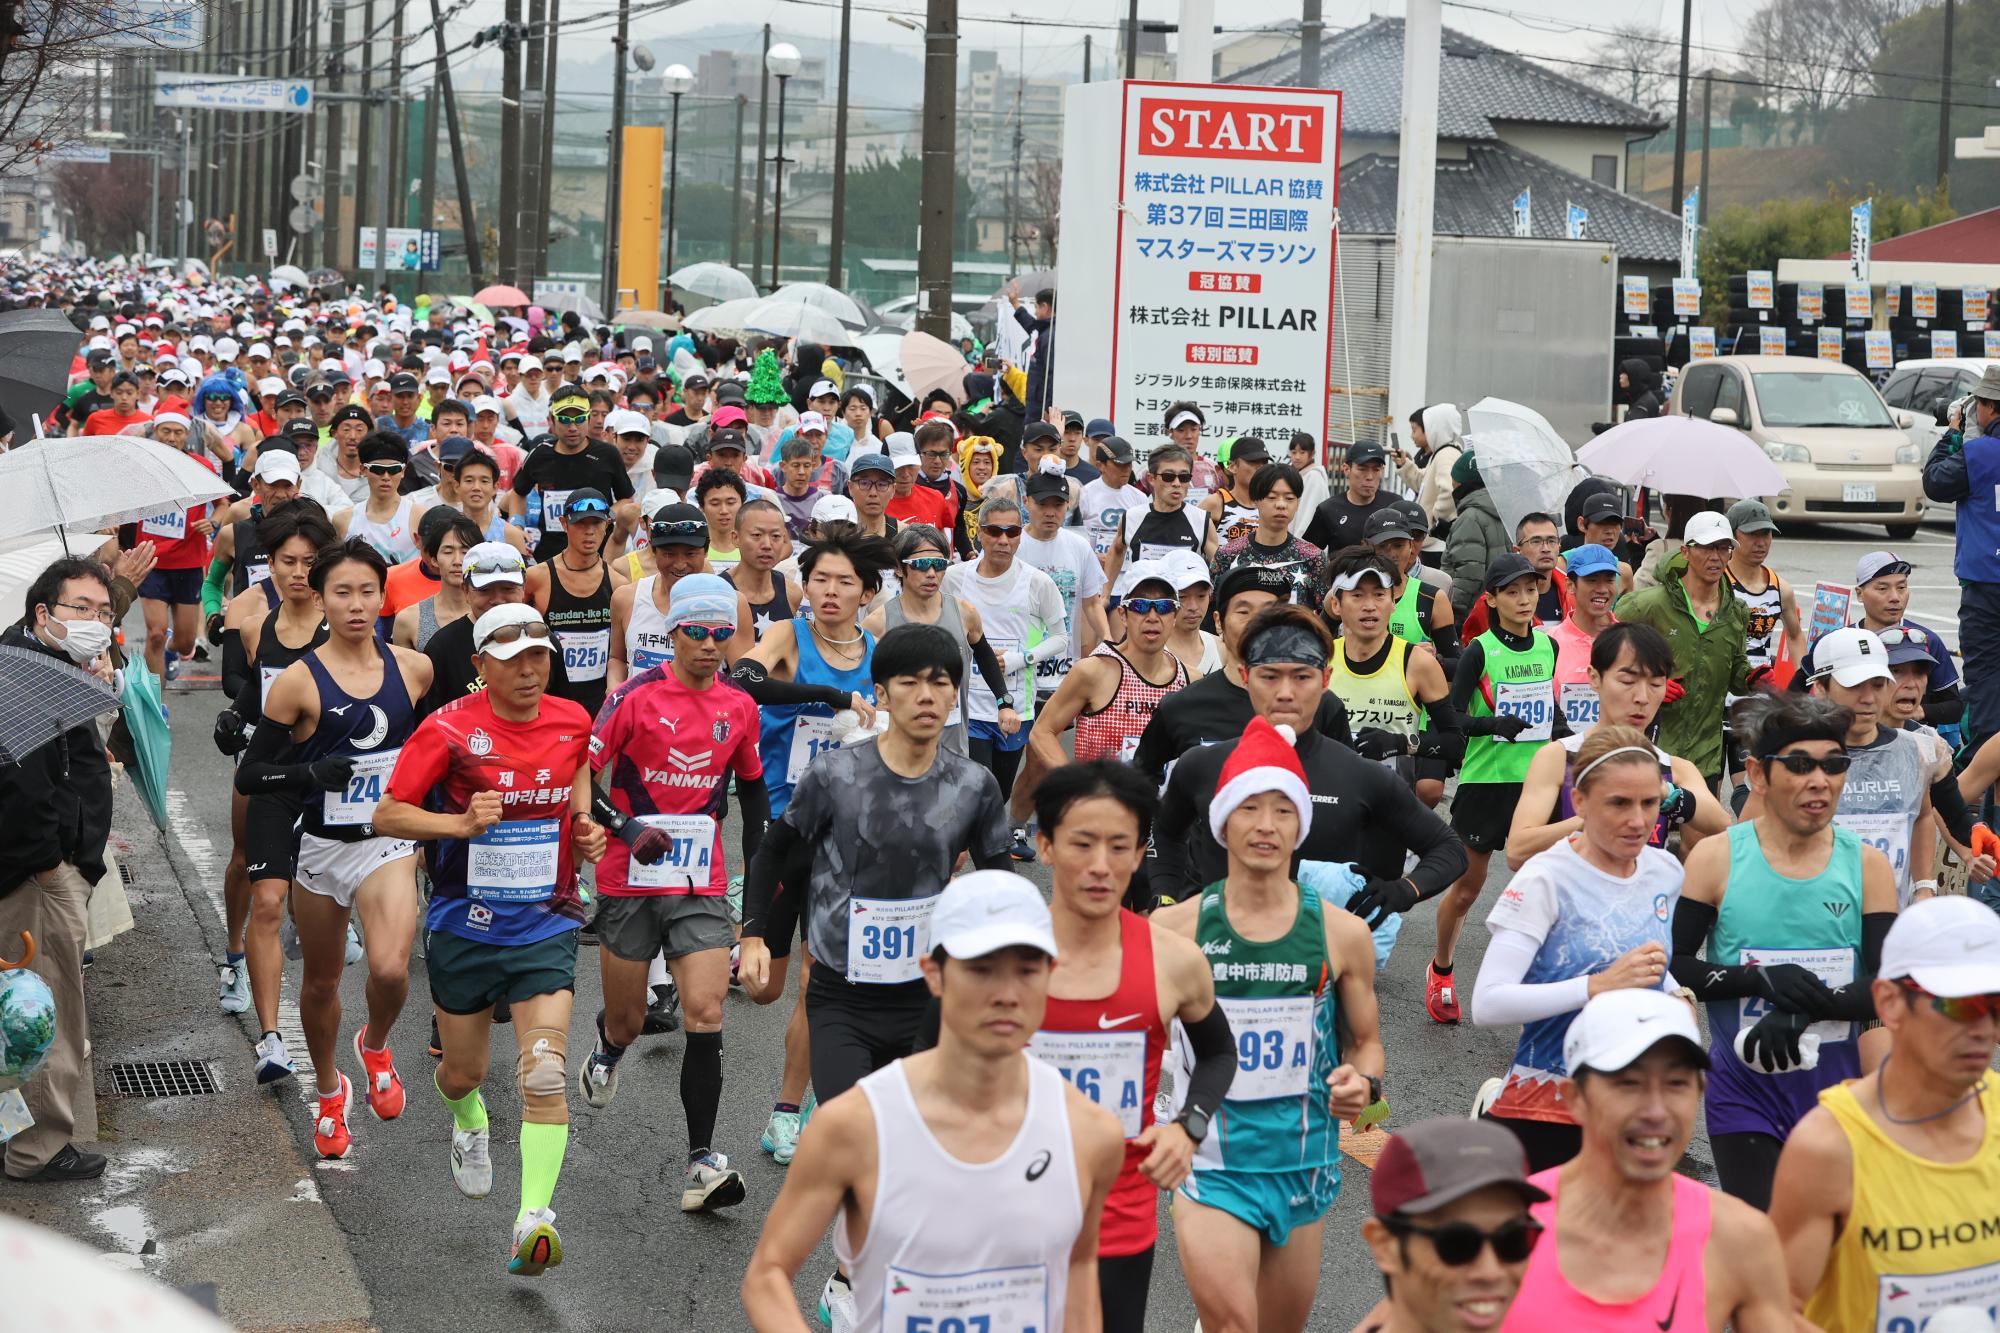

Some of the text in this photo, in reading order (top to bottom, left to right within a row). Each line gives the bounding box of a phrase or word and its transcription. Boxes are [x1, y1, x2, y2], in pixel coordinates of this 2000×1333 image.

[1150, 107, 1312, 154] START
[1134, 172, 1324, 200] 株式会社 PILLAR 協賛
[1146, 203, 1308, 233] 第37回 三田国際
[1136, 237, 1316, 265] マスターズマラソン
[1129, 305, 1317, 332] 株式会社 PILLAR
[1191, 345, 1253, 364] 特別協賛
[1134, 373, 1306, 393] ジブラルタ生命保険株式会社
[1136, 398, 1303, 417] トヨターラ神戸株式会社
[563, 647, 606, 668] 625 A
[1504, 664, 1534, 680] KAGAWA
[1498, 700, 1545, 724] 3739
[498, 768, 551, 788] 제 주
[474, 850, 553, 867] 姉妹都市選手
[697, 847, 709, 867] A
[474, 864, 551, 880] Sister City RUNNER
[862, 925, 915, 960] 391
[1213, 962, 1308, 982] 豊中市消防局
[1238, 1030, 1307, 1072] 93 A
[1120, 1080, 1138, 1109] A
